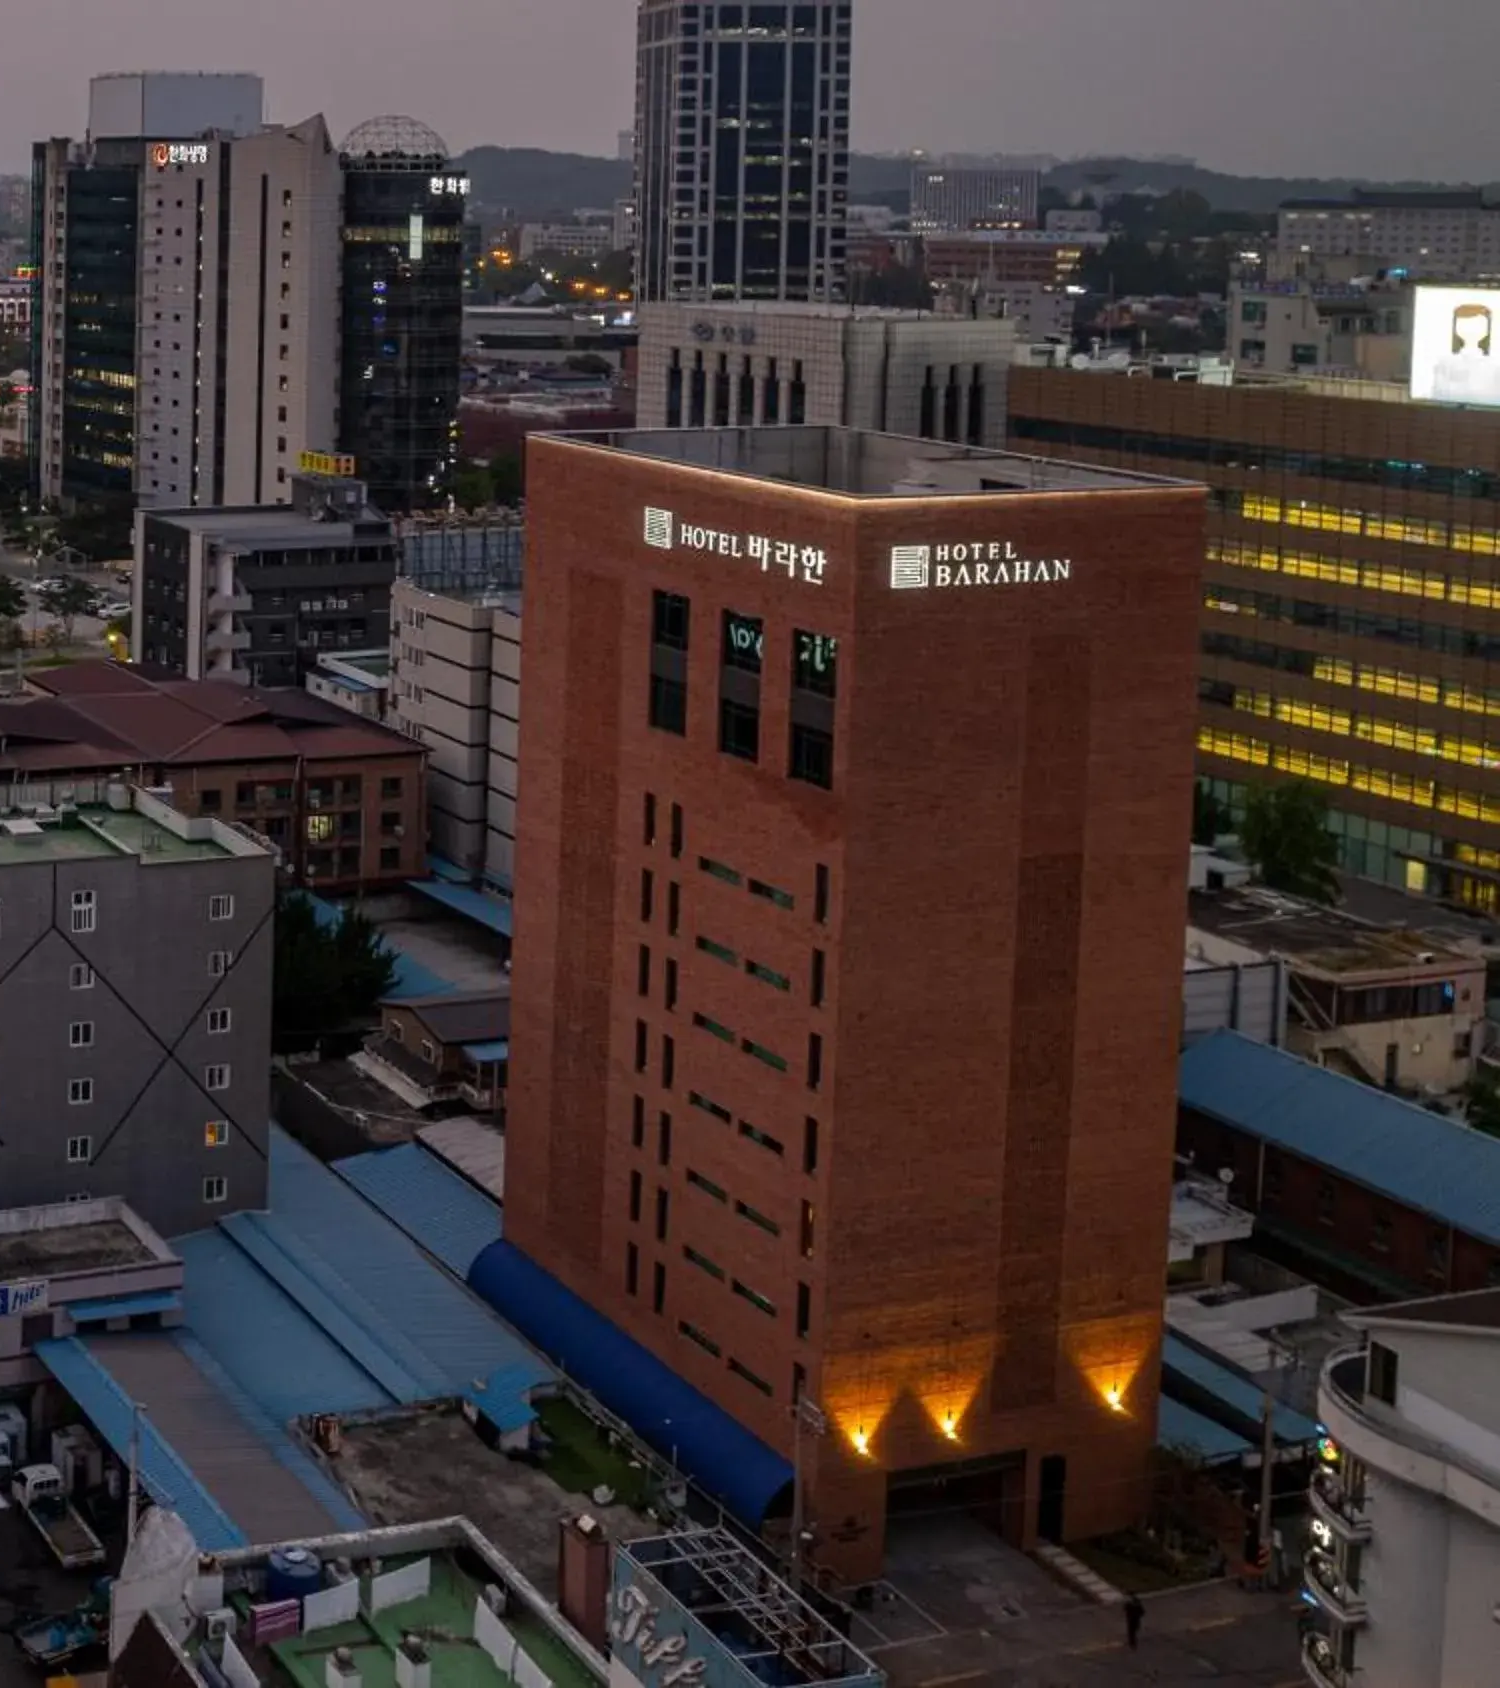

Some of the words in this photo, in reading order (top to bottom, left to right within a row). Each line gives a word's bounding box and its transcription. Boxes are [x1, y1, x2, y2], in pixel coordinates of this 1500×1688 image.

[680, 523, 742, 558] HOTEL
[748, 534, 827, 586] 바라한
[935, 541, 1017, 561] HOTEL
[935, 559, 1071, 587] BARAHAN
